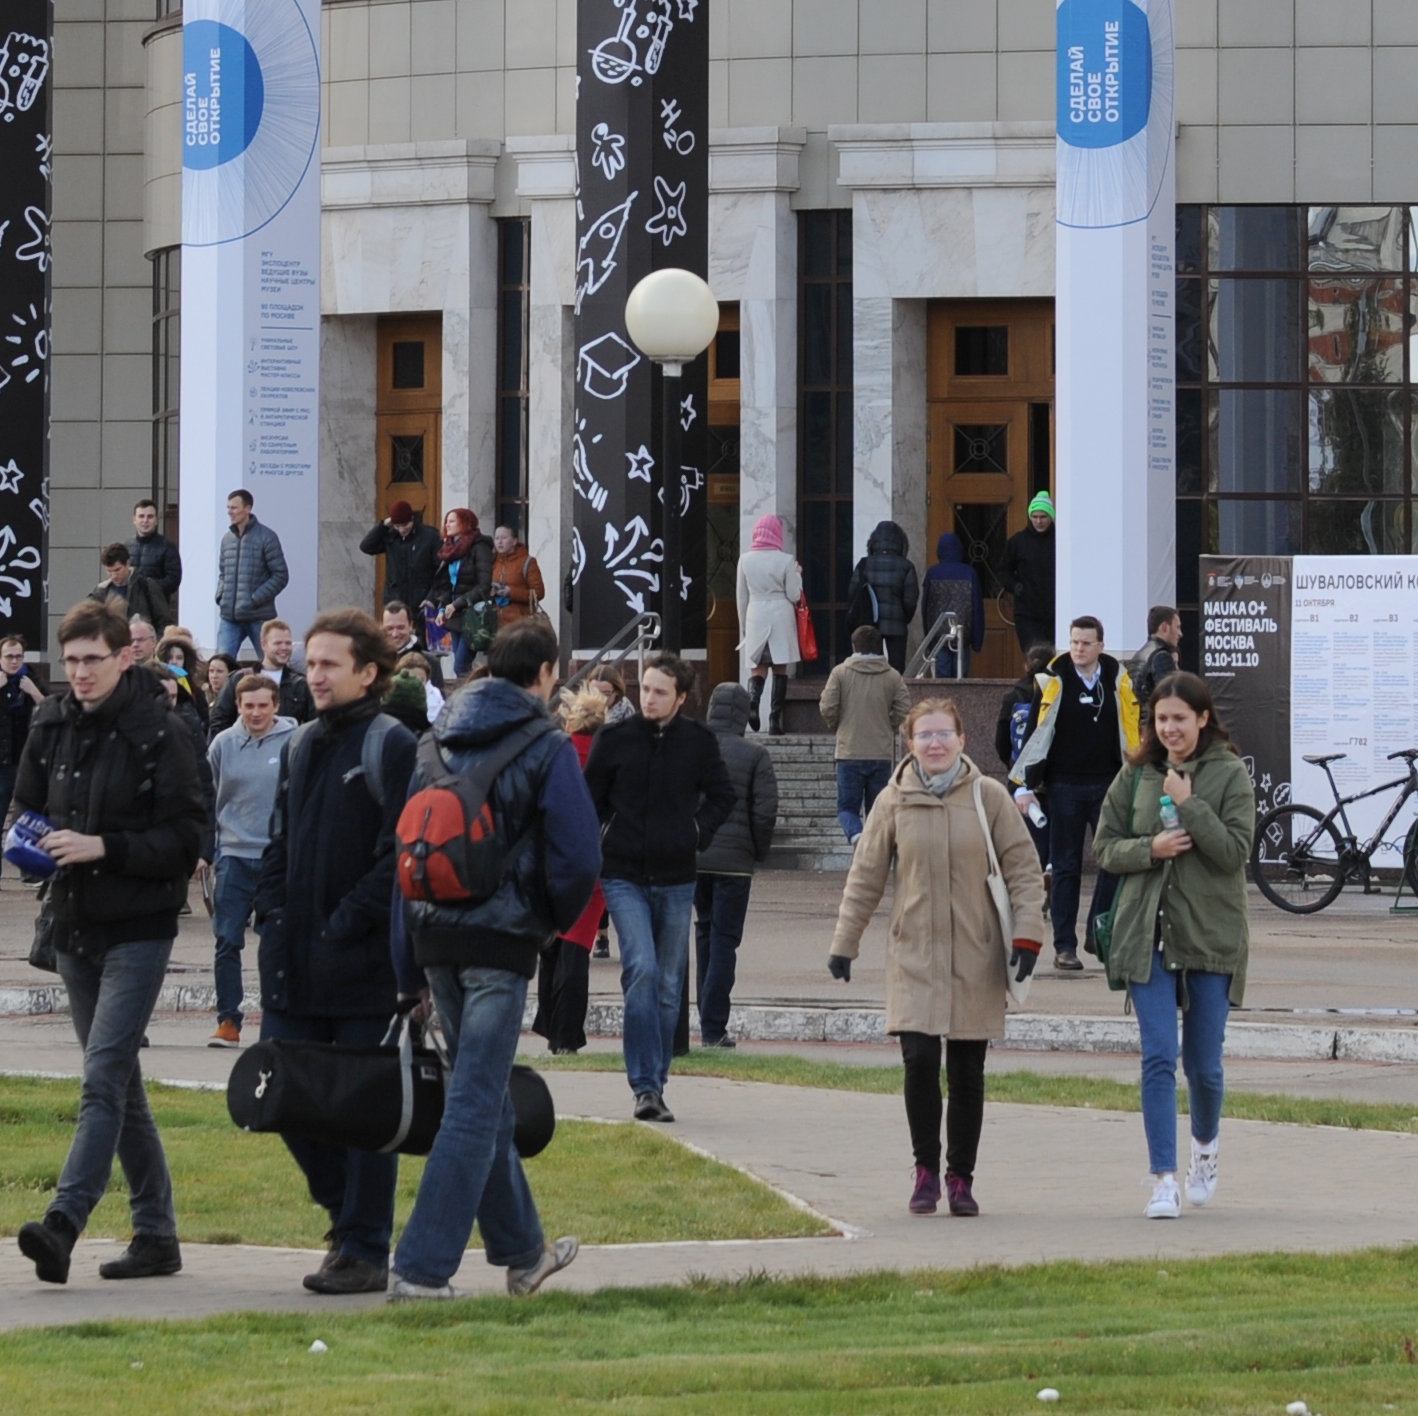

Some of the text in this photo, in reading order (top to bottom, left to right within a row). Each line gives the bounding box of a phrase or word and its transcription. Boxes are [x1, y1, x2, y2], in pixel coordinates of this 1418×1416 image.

[210, 47, 220, 145] ОТКРЫТИЕ
[1068, 45, 1085, 123] СДЕЛАЙ
[1088, 71, 1101, 123] СВОЕ
[1105, 21, 1119, 123] ОТКРЫТИЕ
[184, 73, 197, 146] СДЕЛАЙ
[198, 96, 208, 146] СВОЕ
[1295, 572, 1402, 590] ШУВАЛОВСКИЙ
[1204, 601, 1246, 615] NAUKA
[1204, 619, 1278, 633] ФЕСТИВАЛЬ
[1205, 636, 1255, 650] МОСКВА
[1205, 653, 1259, 667] 9.10-11.10
